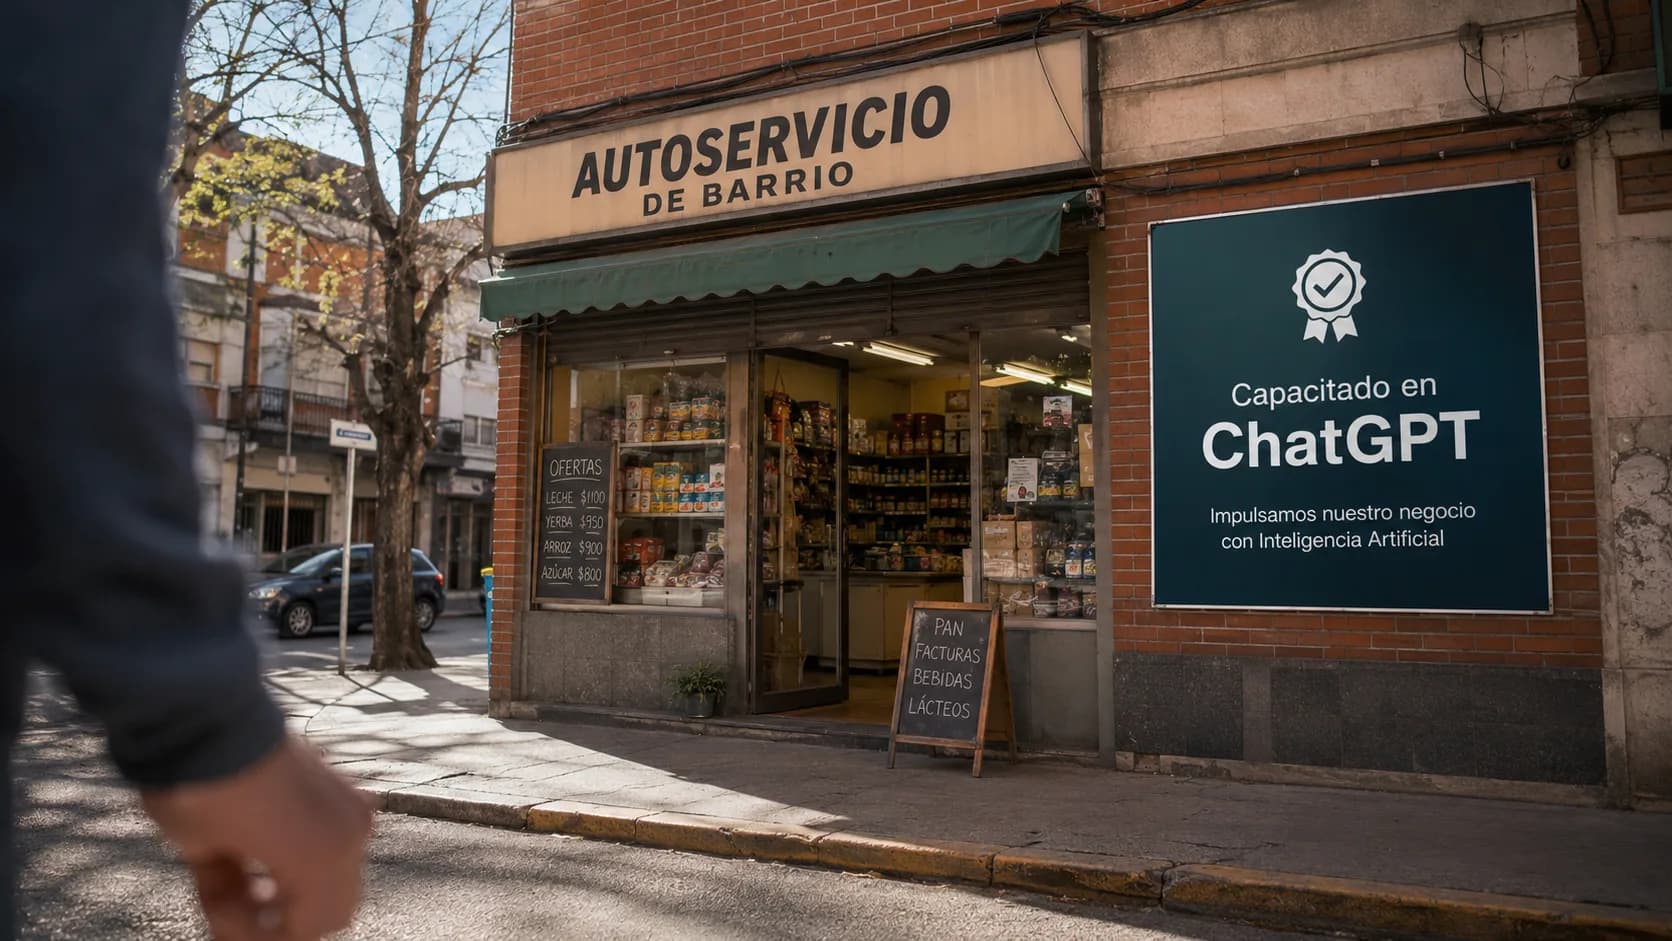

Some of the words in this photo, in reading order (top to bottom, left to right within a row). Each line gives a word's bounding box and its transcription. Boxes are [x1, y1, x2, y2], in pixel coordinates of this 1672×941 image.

[571, 85, 951, 199] AUTOSERVICIO
[642, 188, 685, 217] DE
[702, 161, 854, 207] BARRIO
[1231, 376, 1390, 410] Capacitado
[1400, 377, 1437, 397] en
[1202, 410, 1480, 470] ChatGPT
[550, 458, 602, 476] OFERTAS
[545, 491, 573, 504] LECHE
[580, 490, 605, 505] $1100
[545, 515, 573, 528] YERBA
[580, 514, 604, 529] $950
[1210, 507, 1317, 526] Impulsamos
[1322, 504, 1393, 522] nuestro
[1399, 502, 1476, 523] negocio
[543, 540, 571, 553] ARROZ
[579, 540, 602, 555] $900
[1221, 534, 1253, 549] con
[1259, 531, 1361, 552] Inteligencia
[1368, 529, 1444, 548] Artificial
[541, 563, 573, 580] AZÚCAR
[578, 566, 601, 581] $800
[934, 617, 964, 636] PAN
[915, 643, 981, 664] FACTURAS
[908, 694, 970, 718] LÁCTEOS
